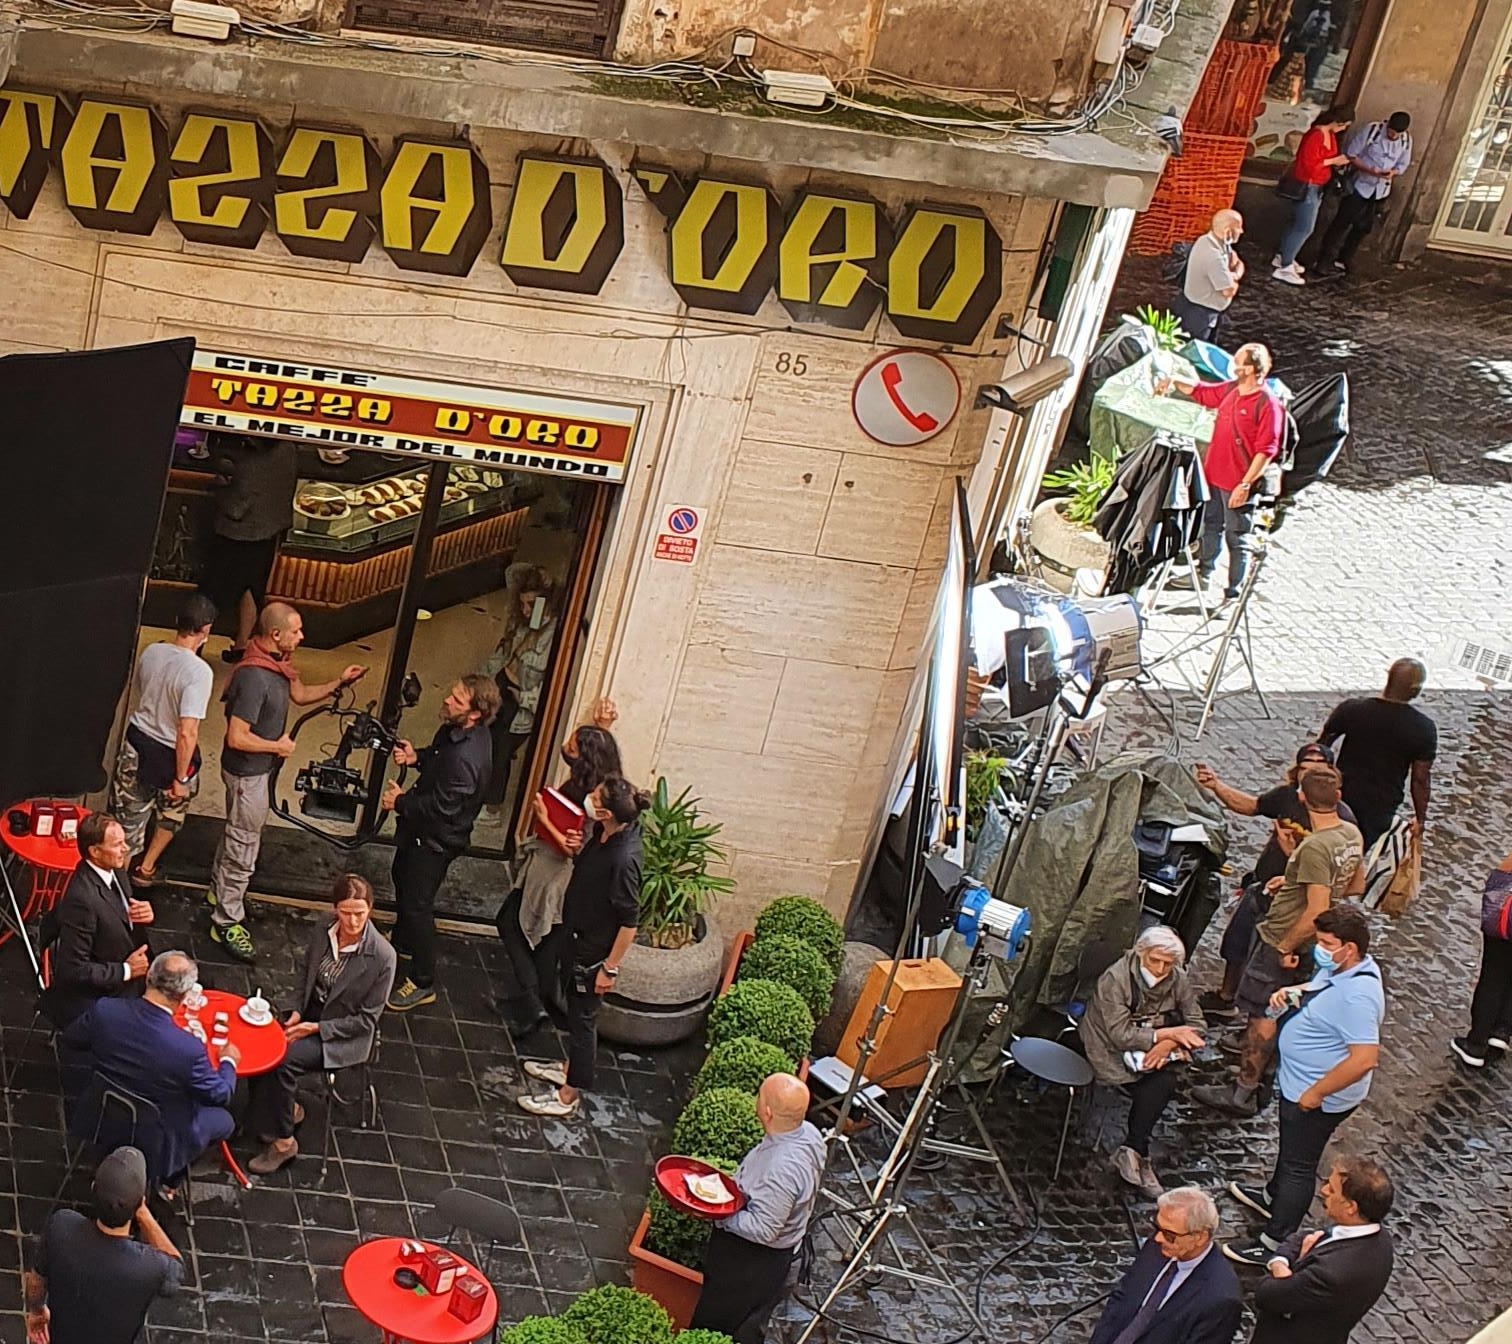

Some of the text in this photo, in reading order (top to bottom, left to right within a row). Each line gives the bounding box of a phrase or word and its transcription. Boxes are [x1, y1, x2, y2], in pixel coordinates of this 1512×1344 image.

[501, 152, 1002, 345] D'ORO
[775, 352, 808, 377] 85
[194, 412, 609, 478] EL MEJOR DEL MUNDO
[211, 378, 601, 451] TAZZA D'ORO
